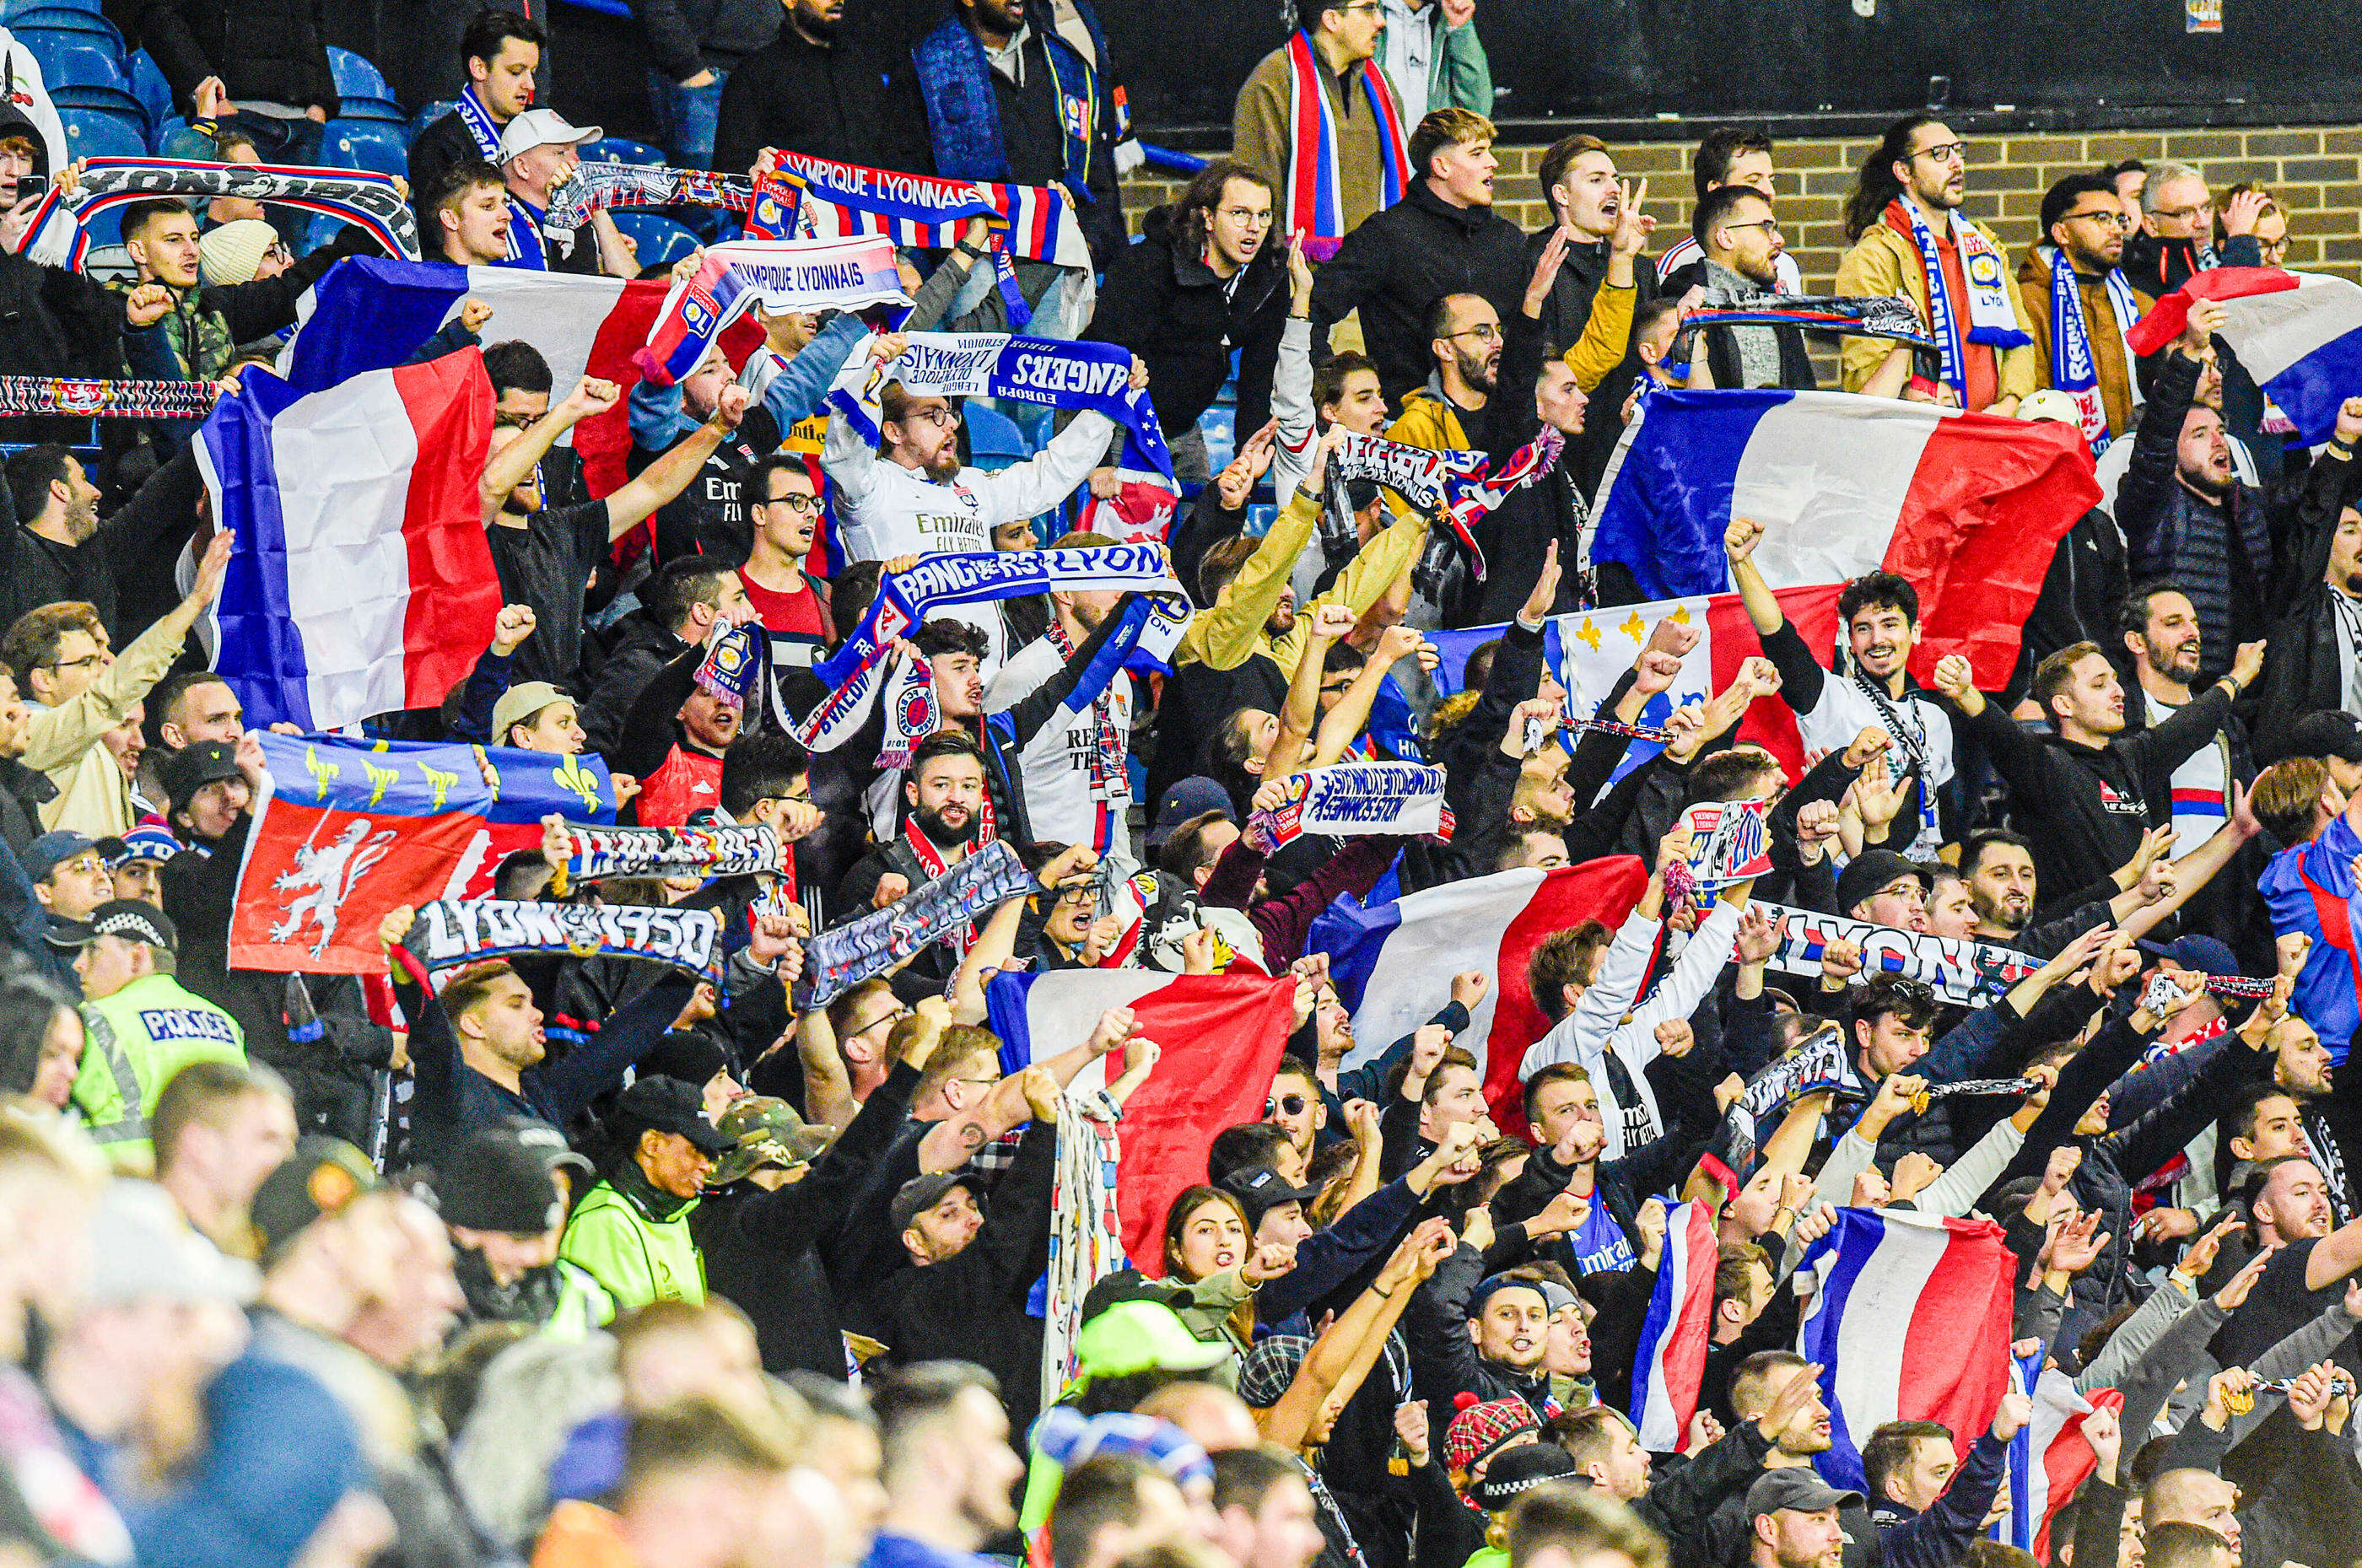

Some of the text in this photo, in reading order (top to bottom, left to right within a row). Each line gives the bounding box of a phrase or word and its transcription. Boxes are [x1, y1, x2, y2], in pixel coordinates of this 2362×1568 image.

[69, 170, 221, 201] YON
[876, 173, 984, 210] LYONNAIS
[731, 262, 866, 291] OLYMPIQUE LYONNAIS
[896, 344, 992, 369] LYONNAIS
[957, 337, 1058, 352] IBROX STADIUM
[909, 369, 972, 385] OLYMPIQUE
[940, 381, 1057, 404] EUROPA LEAGUE
[916, 511, 984, 537] Emirates
[936, 536, 954, 552] FLY
[1047, 545, 1165, 574] LYON
[1330, 768, 1383, 796] LYONNAIS
[1324, 796, 1408, 822] NOUS SOMMES
[1732, 809, 1763, 870] LYO
[420, 899, 718, 970] LYON 1950
[1785, 913, 1976, 1005] LYON
[142, 1010, 235, 1043] POLICE
[1576, 1234, 1635, 1278] mirat
